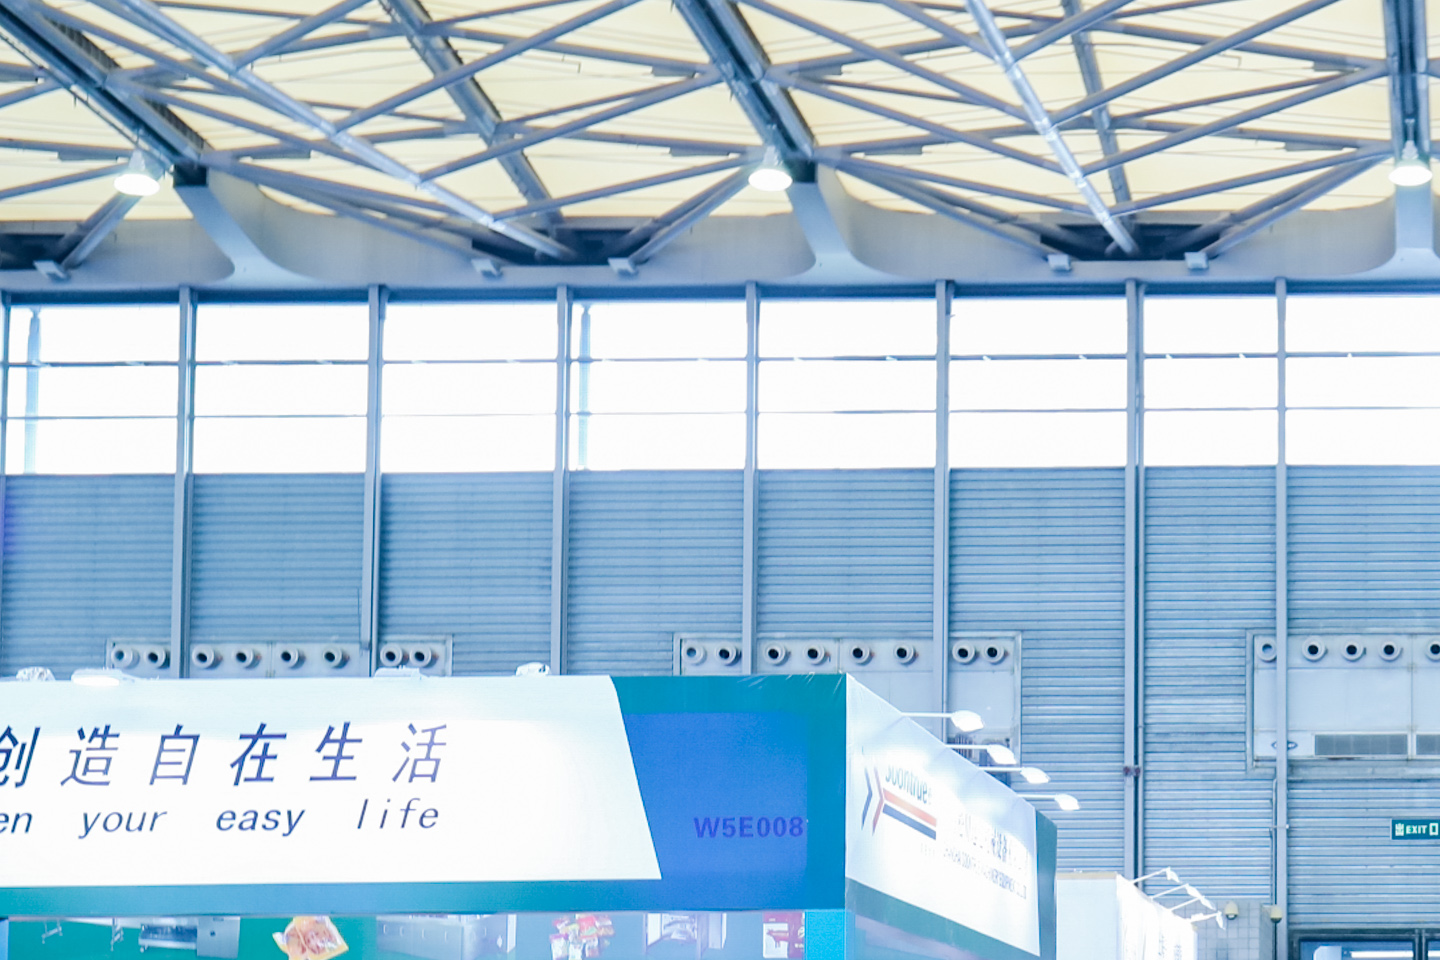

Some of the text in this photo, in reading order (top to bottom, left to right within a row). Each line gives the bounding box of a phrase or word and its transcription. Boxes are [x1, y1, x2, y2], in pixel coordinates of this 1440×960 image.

[0, 721, 448, 788] 创造自在生活
[78, 810, 167, 839] your
[216, 808, 306, 837] easy
[356, 797, 440, 830] life
[694, 815, 804, 839] W5E008
[1406, 825, 1428, 834] EXIT
